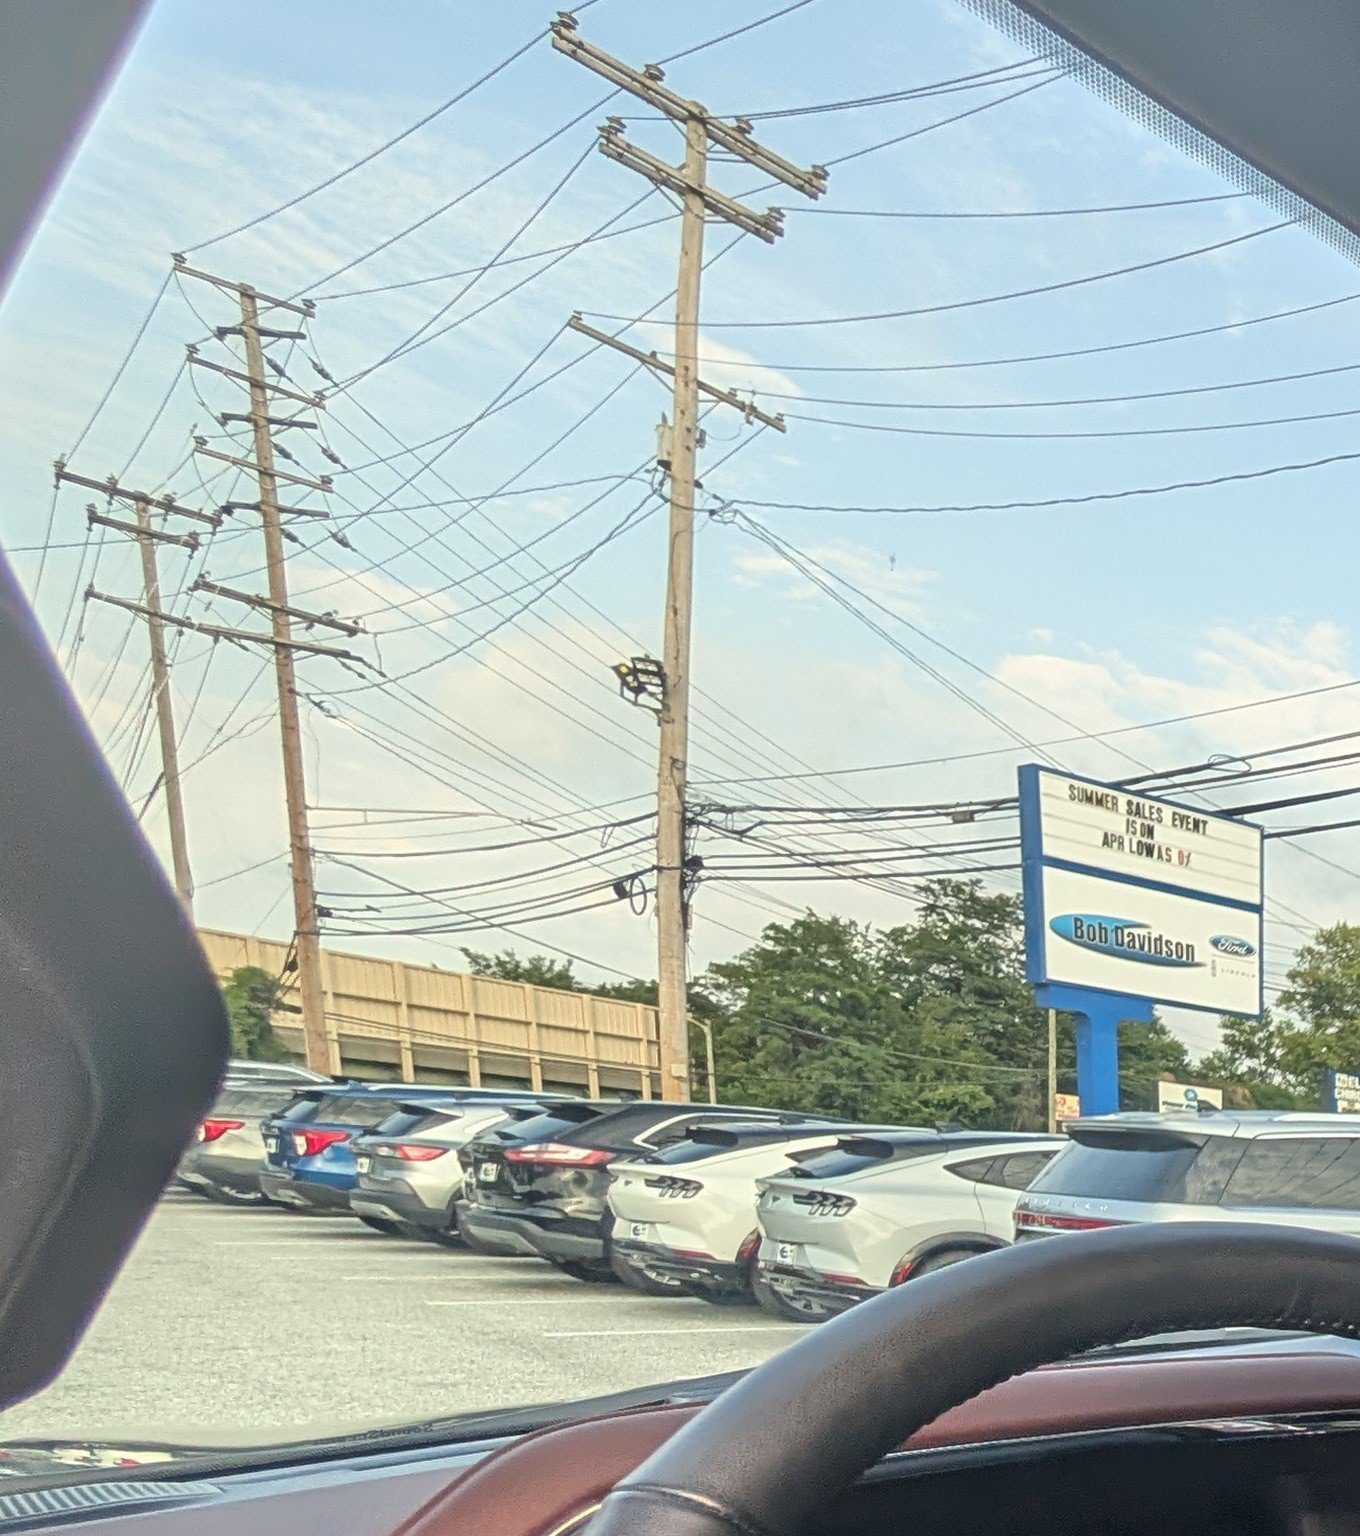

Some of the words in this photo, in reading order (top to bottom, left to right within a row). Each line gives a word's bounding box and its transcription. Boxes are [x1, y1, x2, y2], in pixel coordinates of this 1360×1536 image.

[1068, 784, 1119, 812] SUMMER
[1126, 799, 1163, 824] SALES
[1171, 811, 1208, 835] EVENT
[1126, 818, 1137, 835] IS
[1140, 822, 1154, 840] ON
[1102, 831, 1124, 852] APR
[1129, 837, 1154, 859] LOW
[1157, 844, 1172, 863] AS
[1074, 917, 1109, 945] Bob
[1114, 926, 1196, 963] Davidson
